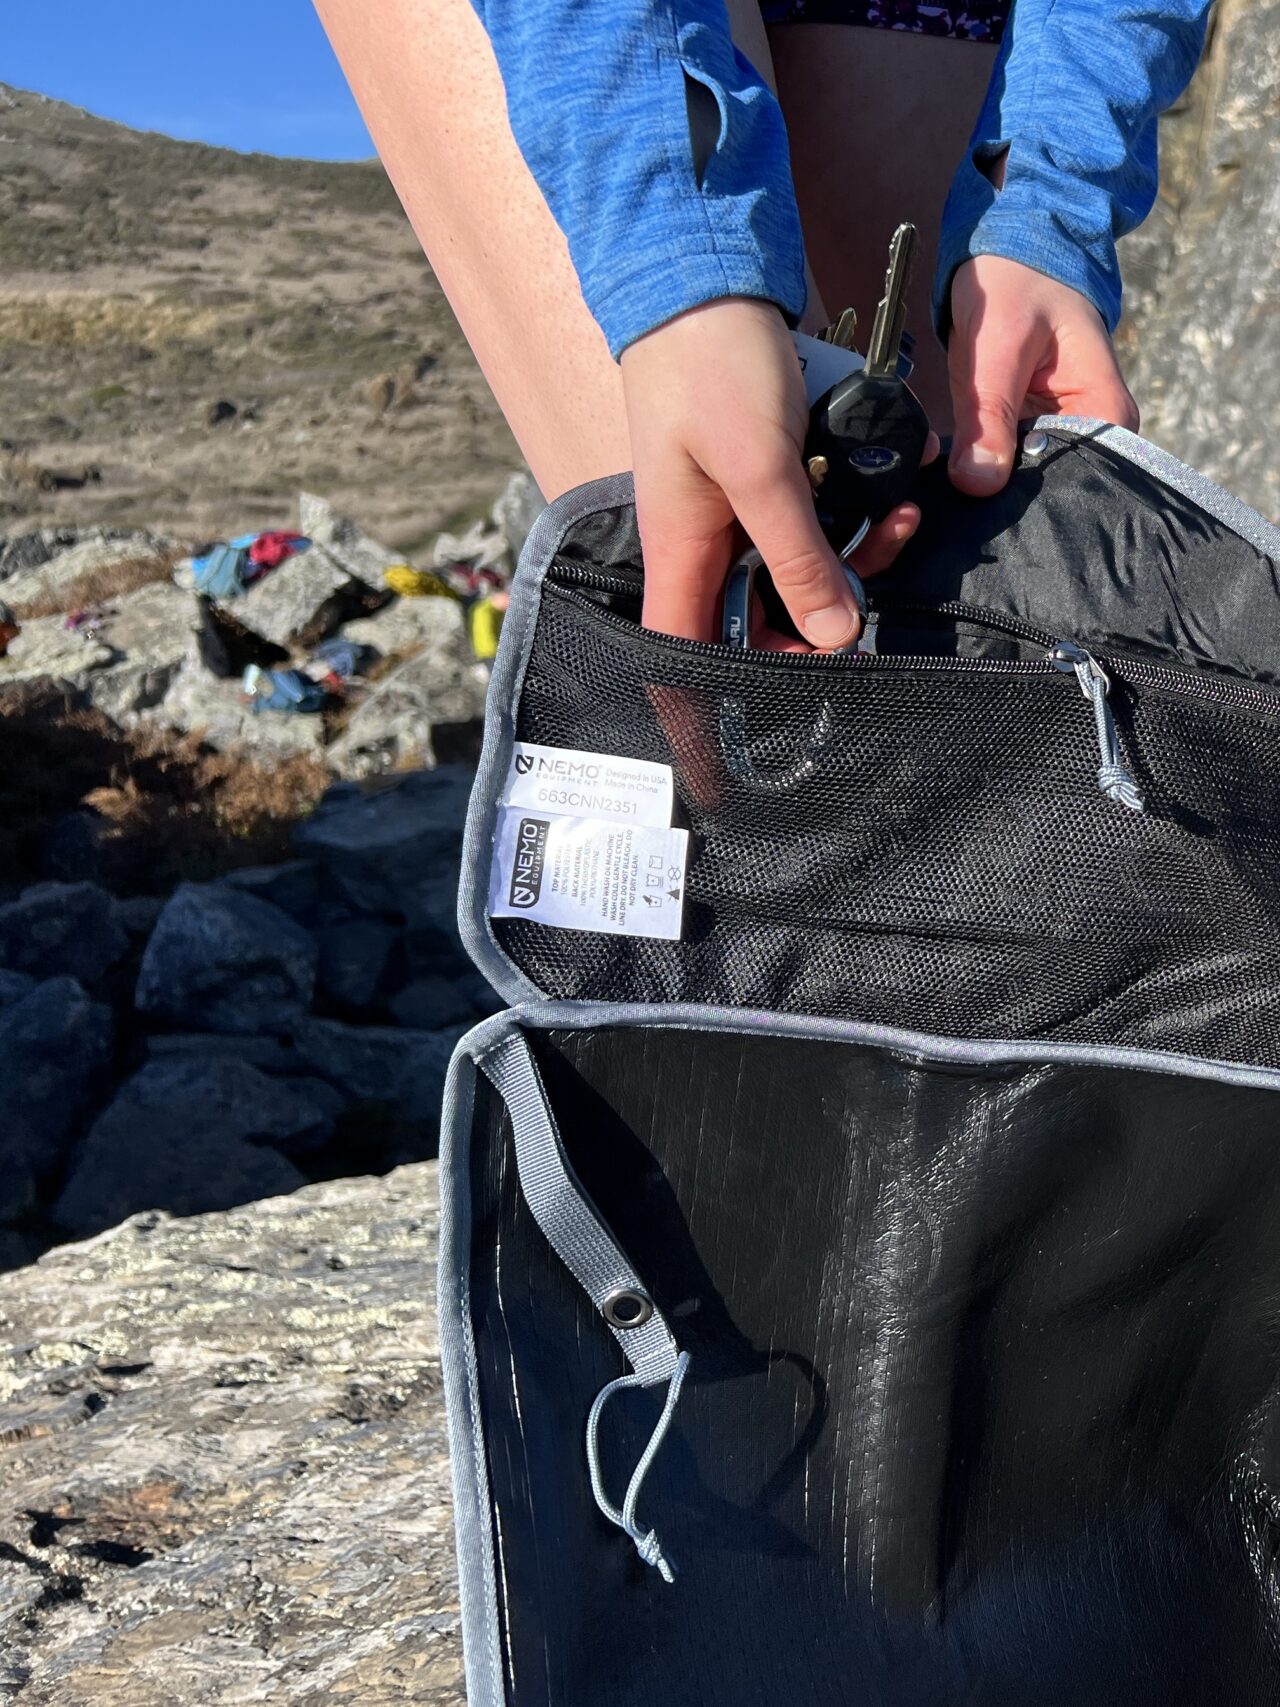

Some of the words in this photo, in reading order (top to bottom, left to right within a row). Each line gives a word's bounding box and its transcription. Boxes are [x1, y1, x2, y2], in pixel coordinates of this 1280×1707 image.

[729, 616, 741, 648] ARU
[536, 773, 598, 786] EQUIPMENT
[538, 758, 599, 778] NEMO
[606, 769, 640, 781] Designed
[643, 773, 649, 782] in
[651, 776, 667, 785] USA
[605, 779, 626, 789] Made
[628, 781, 634, 789] in
[636, 783, 658, 793] China
[538, 788, 637, 814] 663CNN2351
[515, 824, 537, 883] NEMO
[532, 826, 545, 885] EQUIPMENT
[553, 846, 563, 877] MATERIAL
[573, 847, 582, 878] MATERIAL
[581, 837, 592, 889] THERMOPLASTIC
[606, 834, 614, 865] MACHINE
[620, 885, 627, 895] DO
[626, 830, 632, 840] DO
[604, 866, 611, 876] OR
[613, 856, 621, 880] GENTLE
[571, 880, 579, 897] BACK
